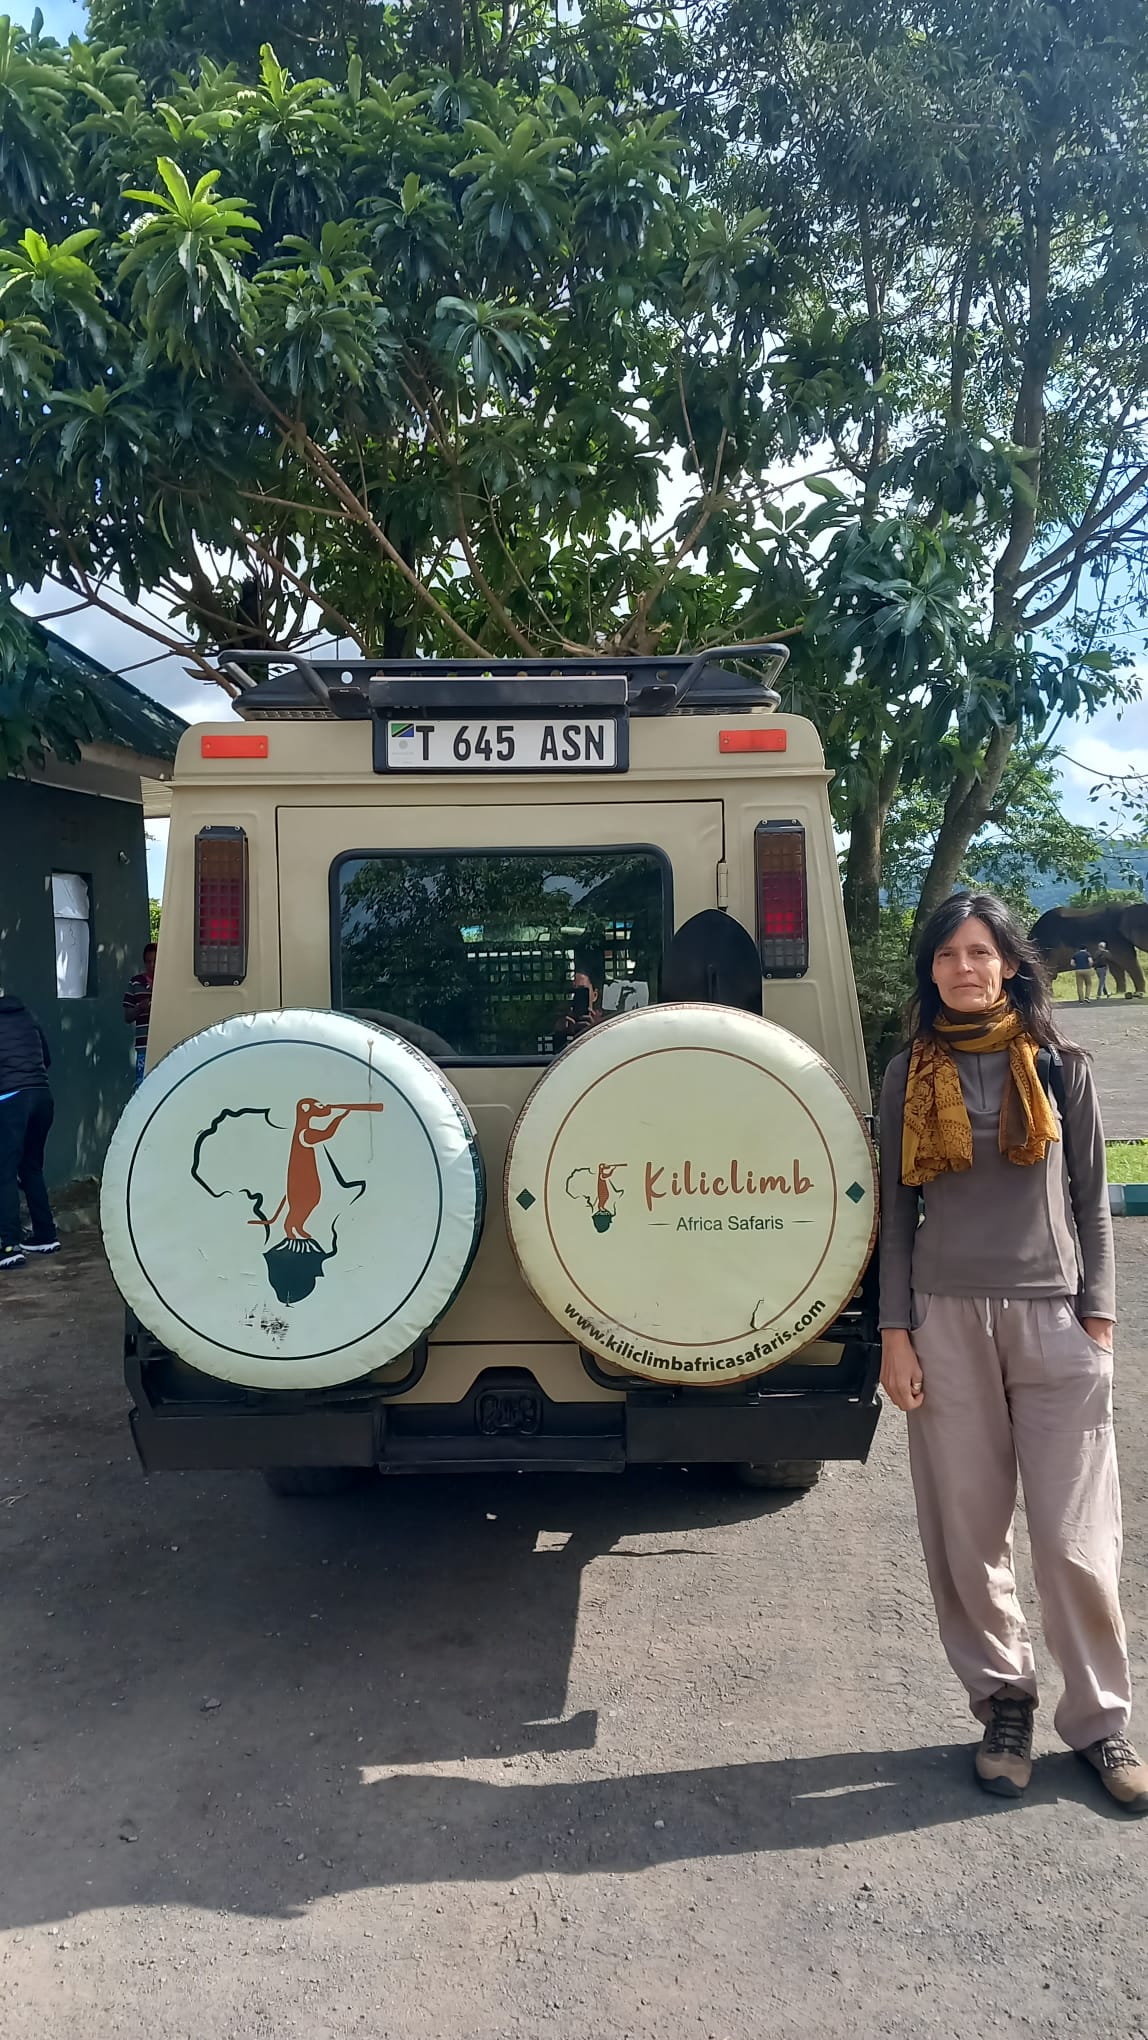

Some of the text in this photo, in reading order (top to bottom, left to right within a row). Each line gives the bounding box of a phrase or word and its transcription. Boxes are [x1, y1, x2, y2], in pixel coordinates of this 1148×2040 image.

[415, 725, 604, 761] T 645 ASN
[645, 1159, 815, 1212] Kiliclimb
[676, 1215, 784, 1231] Africa Safaris
[564, 1299, 826, 1372] www.kiliclimbafricasafaris.com
